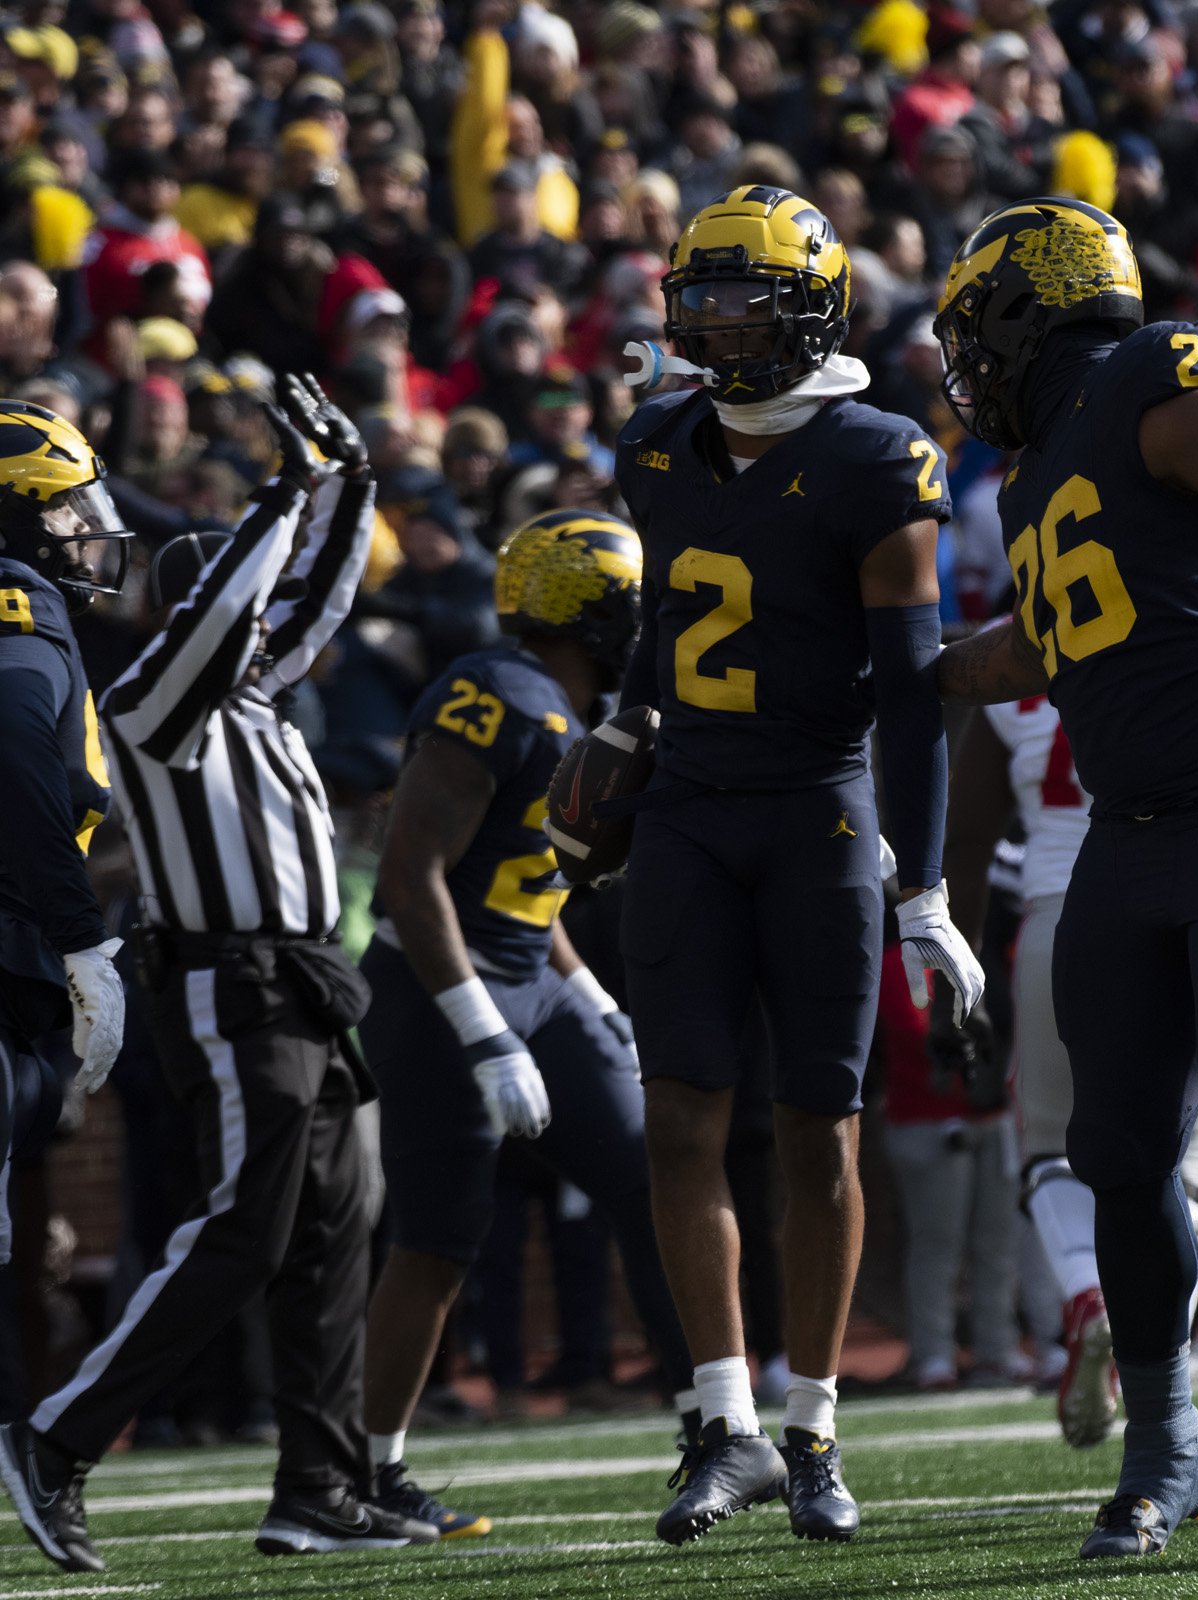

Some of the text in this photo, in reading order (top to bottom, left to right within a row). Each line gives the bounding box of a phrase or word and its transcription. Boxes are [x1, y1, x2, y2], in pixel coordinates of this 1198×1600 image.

[909, 440, 942, 501] 2
[669, 546, 757, 713] 2
[1008, 473, 1137, 681] 26
[435, 678, 506, 748] 23
